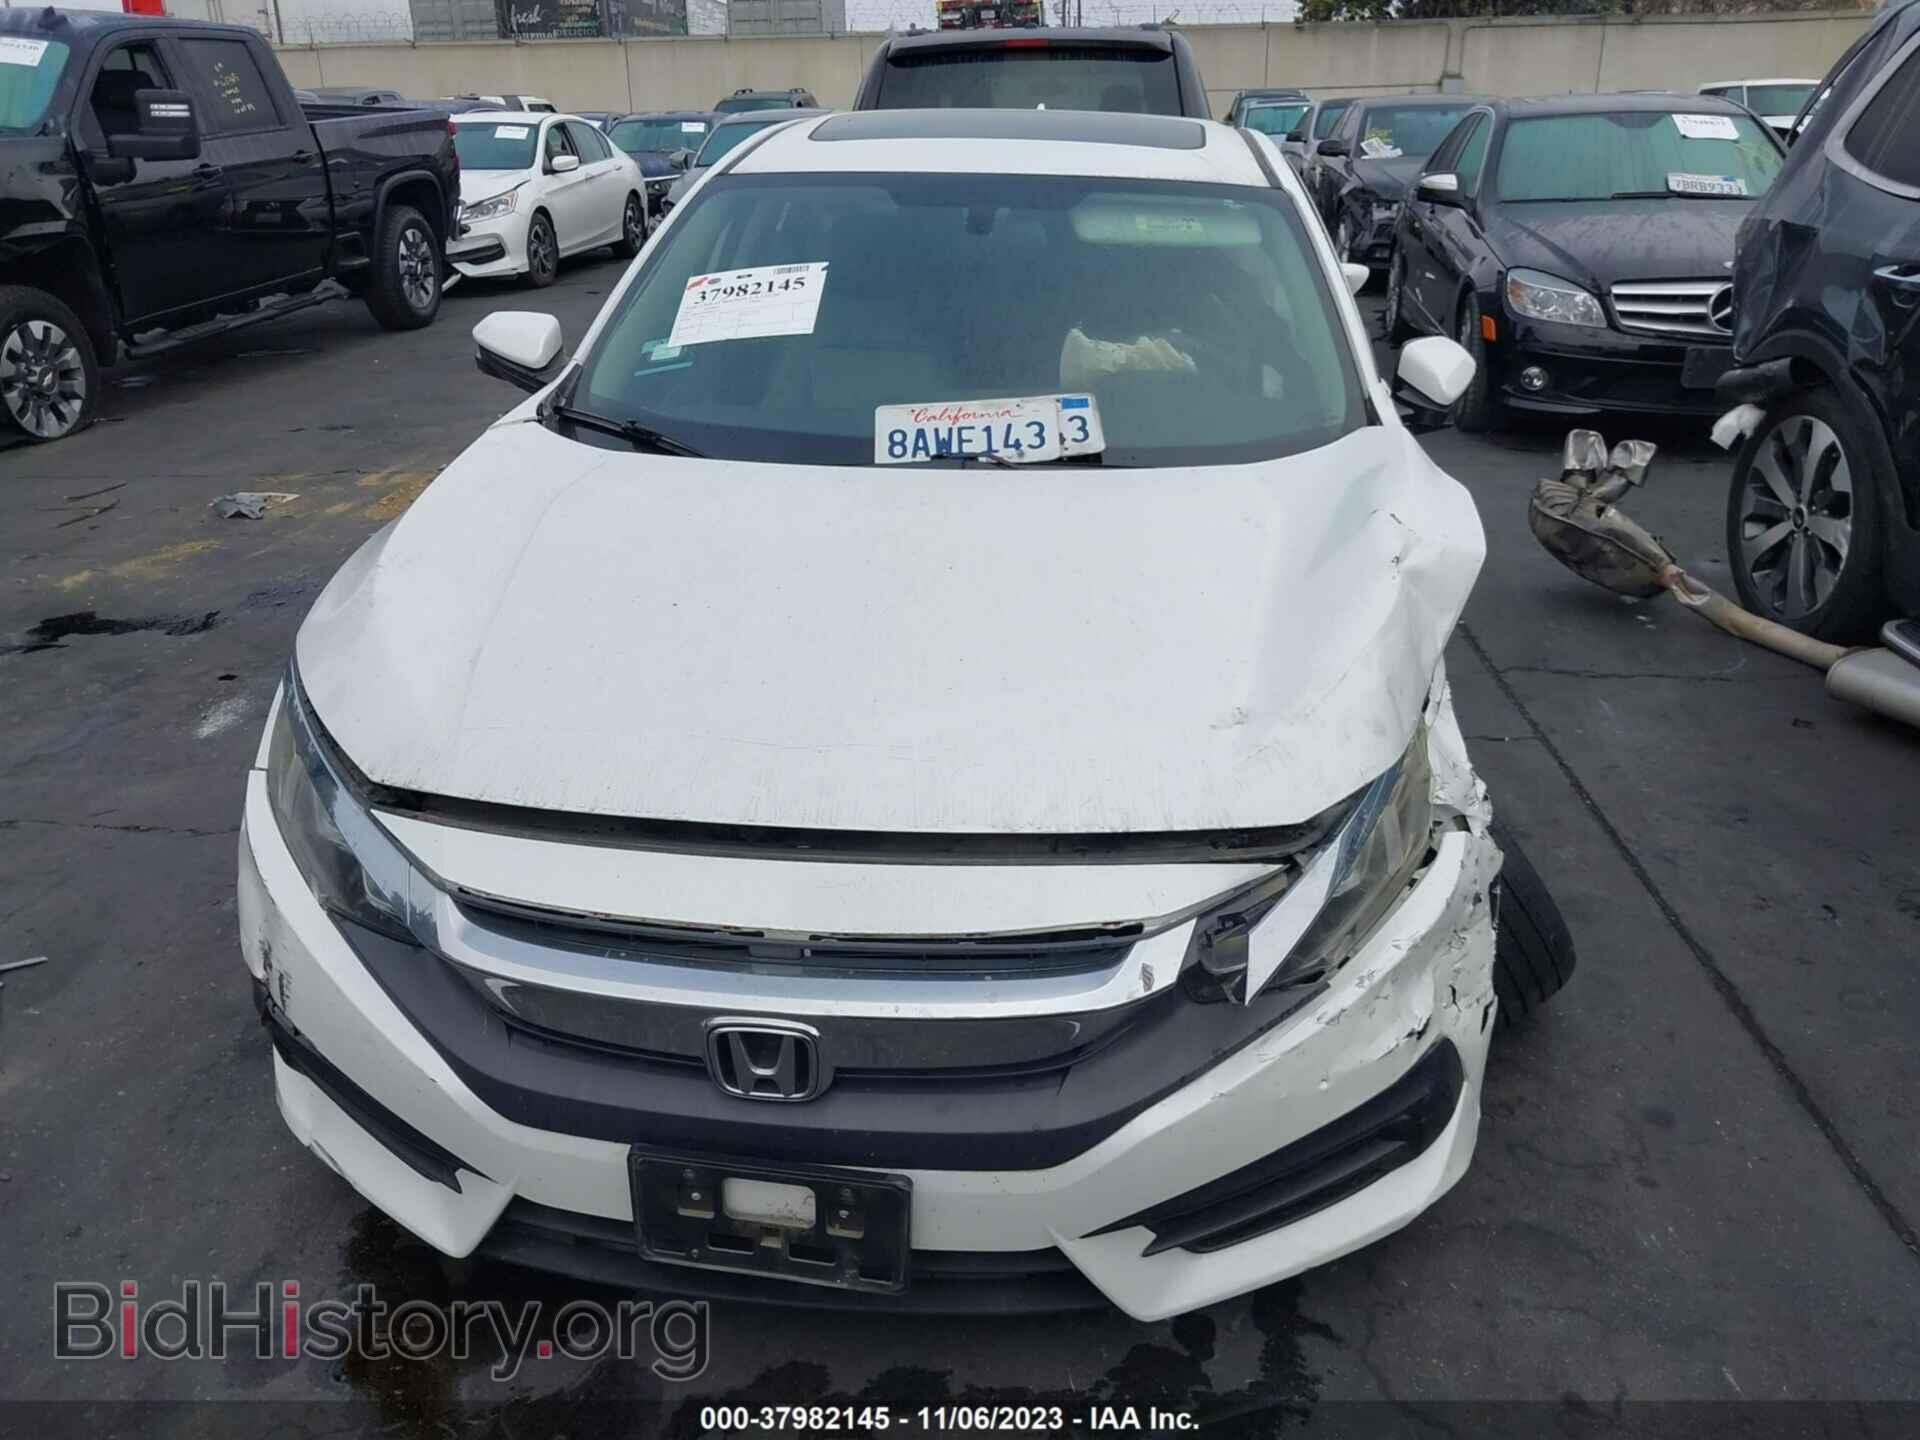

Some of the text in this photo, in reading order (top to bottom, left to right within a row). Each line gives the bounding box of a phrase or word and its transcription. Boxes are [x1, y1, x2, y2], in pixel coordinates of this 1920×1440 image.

[693, 276, 807, 305] 37982145
[912, 406, 1017, 425] California
[887, 420, 1047, 459] 8AWE143
